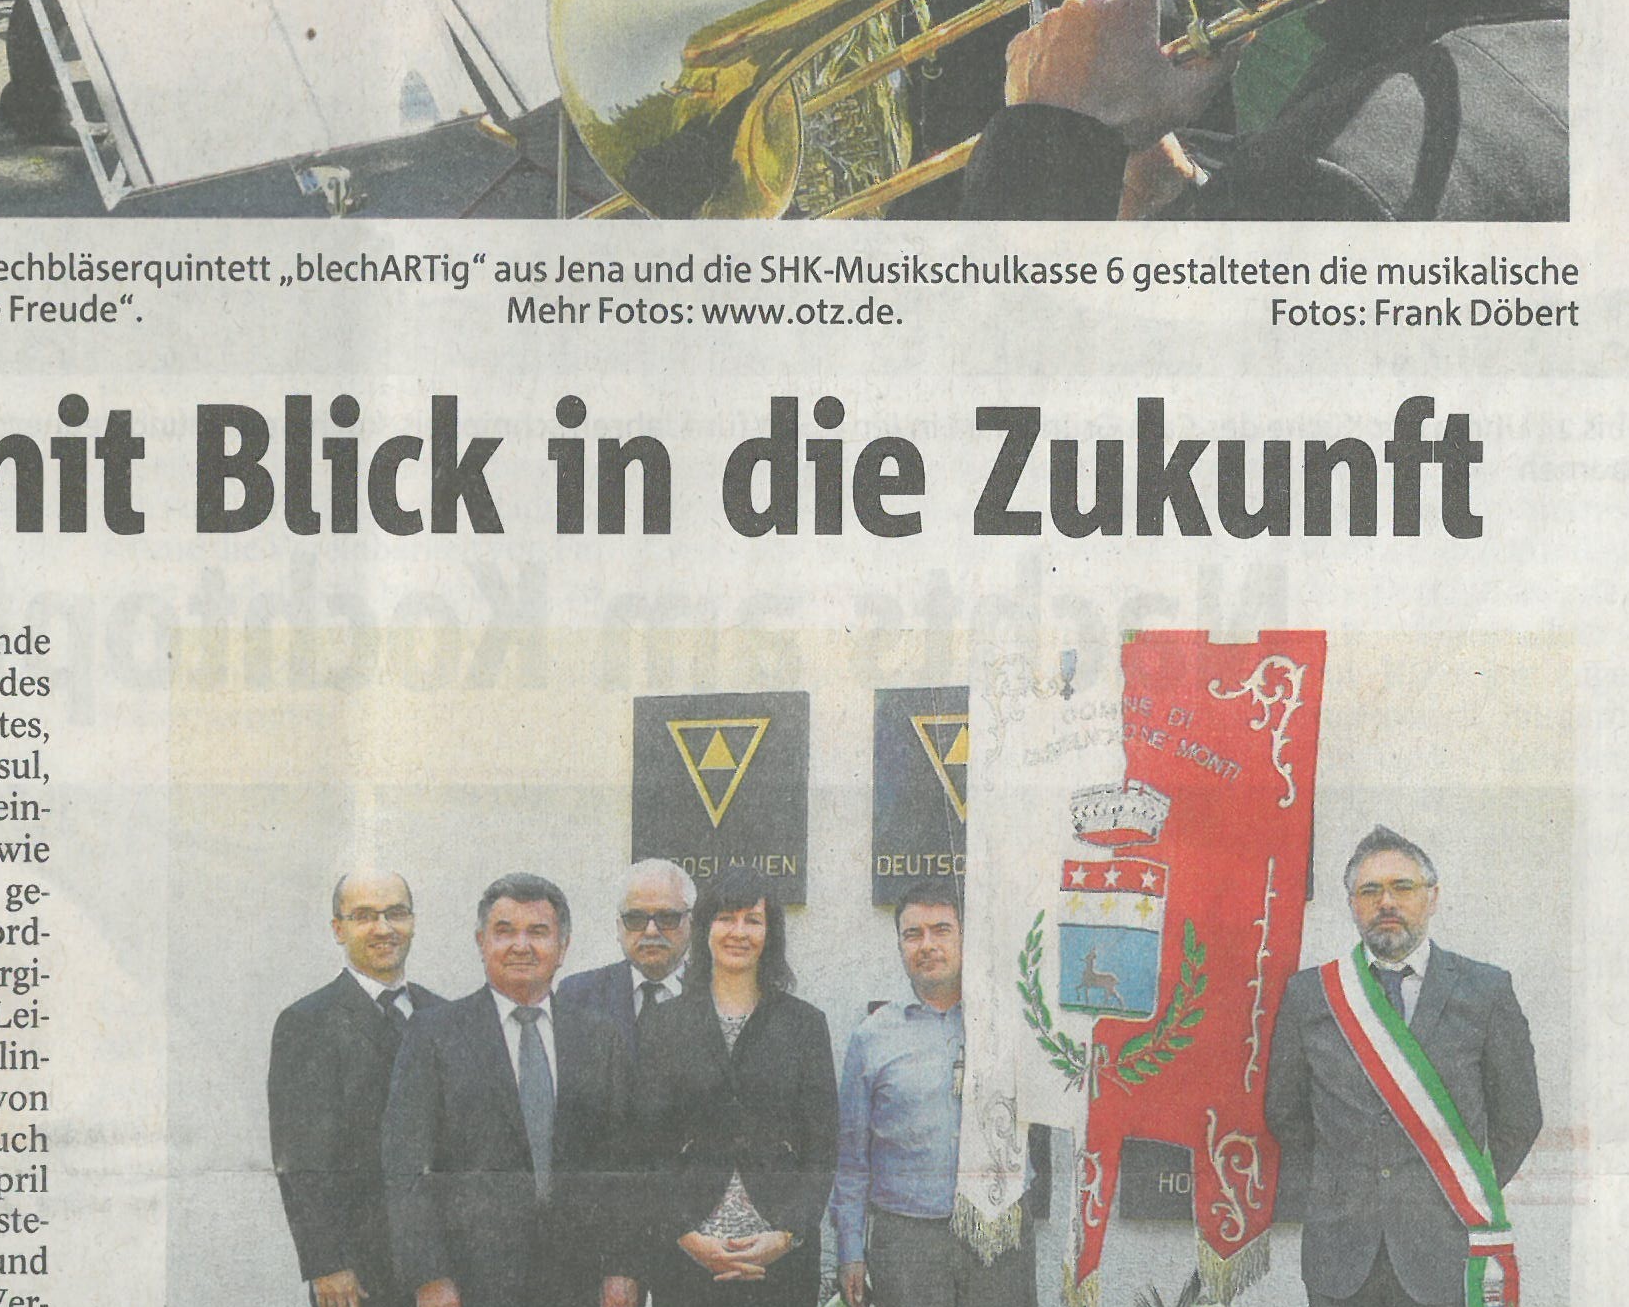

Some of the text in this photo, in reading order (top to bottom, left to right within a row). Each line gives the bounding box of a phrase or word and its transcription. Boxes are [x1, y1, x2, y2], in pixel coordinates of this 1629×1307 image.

[494, 261, 548, 283] aus
[554, 255, 624, 283] Jena
[634, 253, 694, 284] und
[703, 253, 752, 284] die
[760, 254, 1098, 285] SHK-Musikschulkasse
[1106, 256, 1125, 285] 6
[1132, 255, 1310, 293] gestalteten
[1319, 255, 1368, 285] die
[1377, 255, 1579, 286] musikalische
[507, 294, 903, 325] Mehr Fotos: www.otz.de.
[1271, 297, 1580, 327] Fotos: Frank Döbert
[196, 393, 505, 537] Blick
[547, 394, 672, 535] in
[722, 395, 926, 538] die
[973, 395, 1484, 540] Zukunft
[5, 883, 50, 913] ge-
